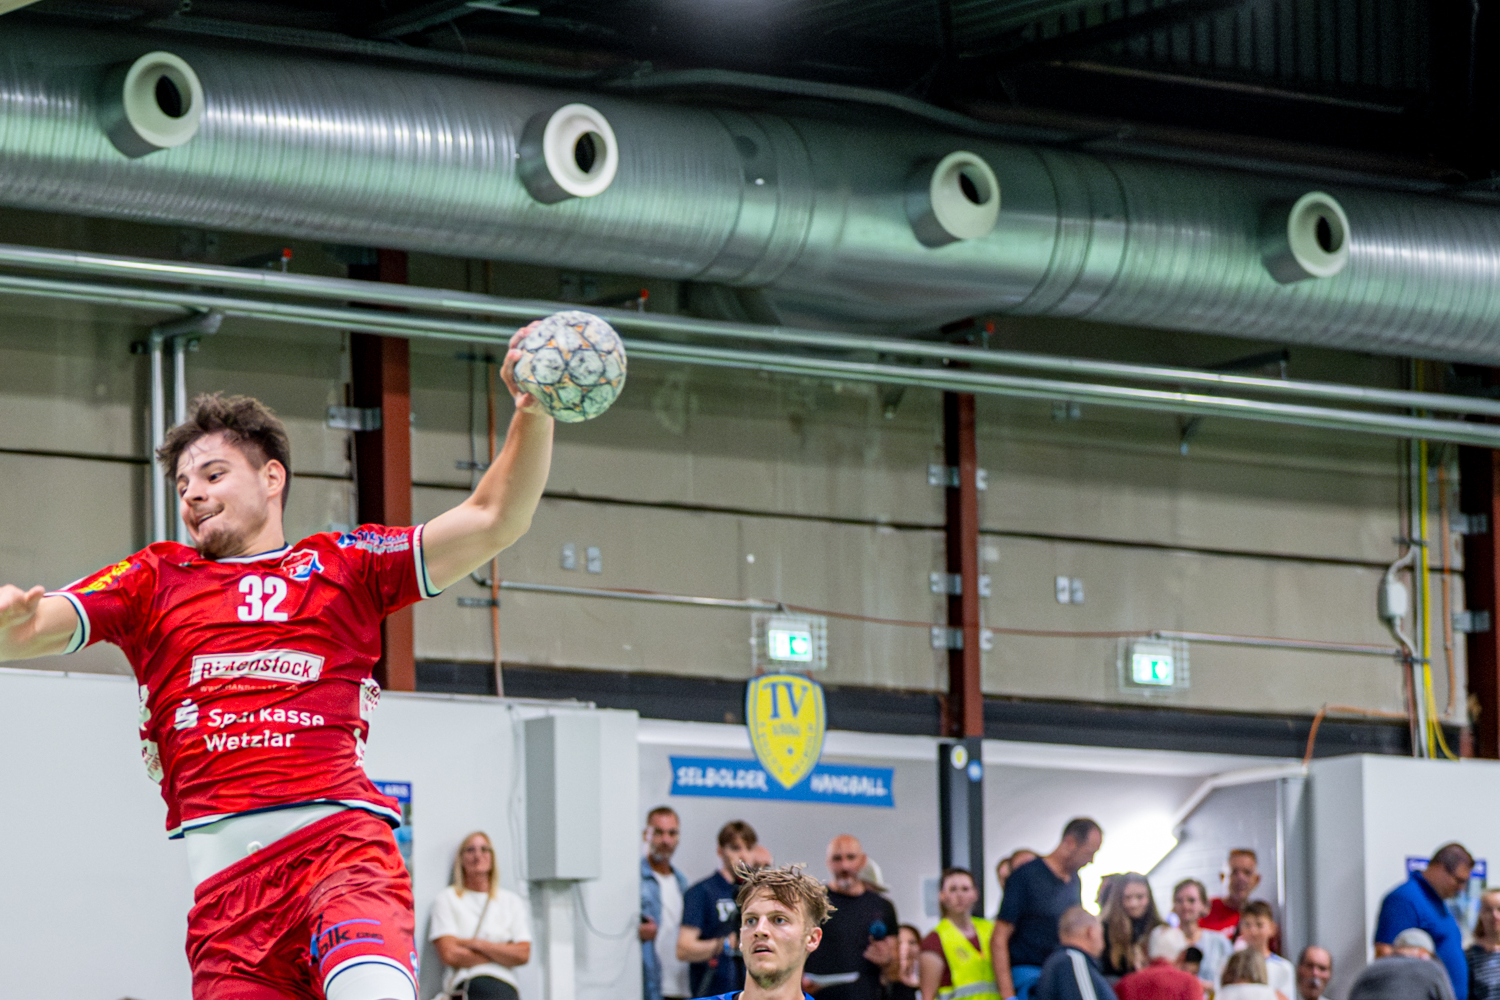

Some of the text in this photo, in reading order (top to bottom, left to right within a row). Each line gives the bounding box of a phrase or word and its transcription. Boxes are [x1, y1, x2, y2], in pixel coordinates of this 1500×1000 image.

[237, 574, 289, 623] 32
[762, 682, 810, 719] TV
[207, 707, 325, 729] Sparkasse
[203, 729, 295, 752] Wetzlar
[676, 765, 889, 797] SELBOLDER HANDBALL
